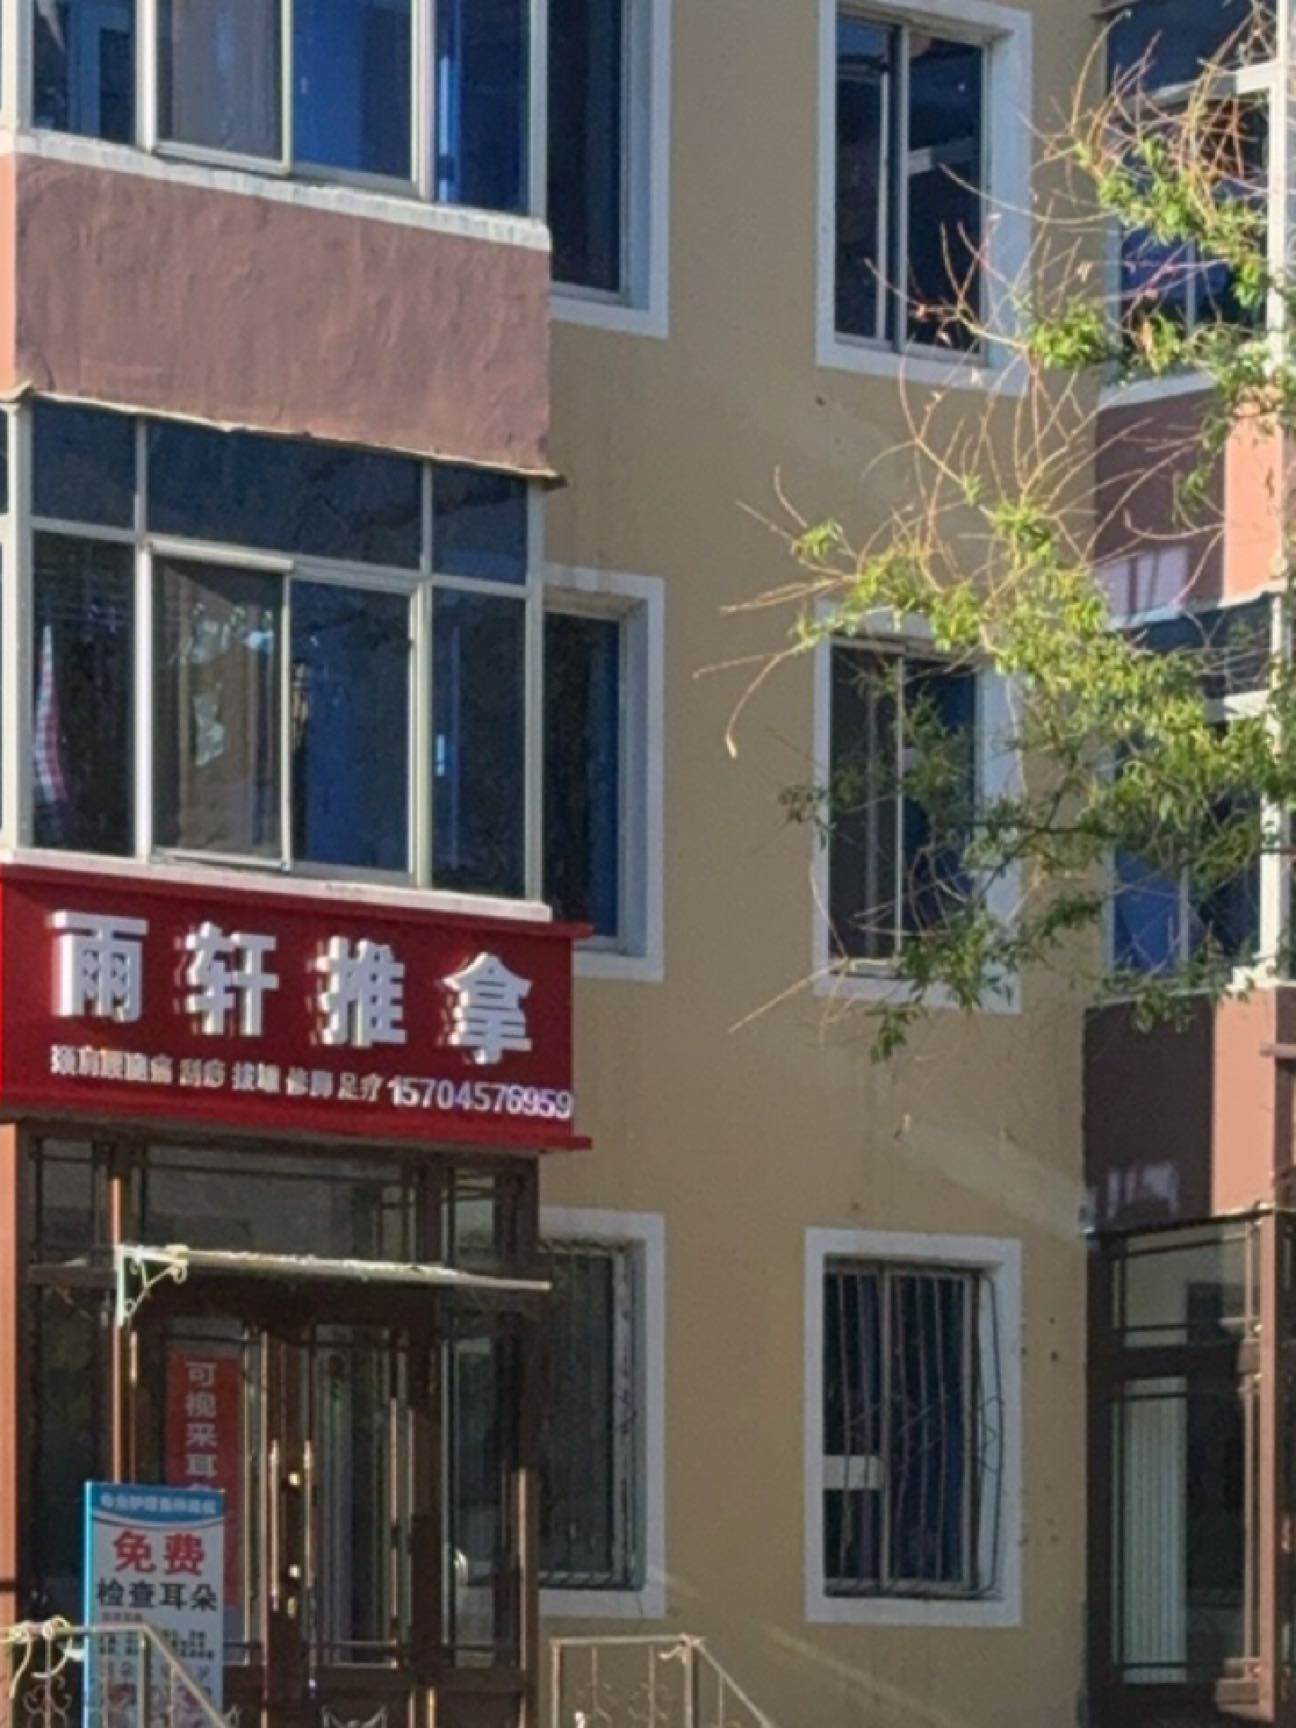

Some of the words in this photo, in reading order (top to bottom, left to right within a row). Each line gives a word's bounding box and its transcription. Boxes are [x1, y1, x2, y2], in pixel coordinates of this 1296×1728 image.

[48, 909, 534, 1066] 雨轩推拿
[337, 1071, 384, 1103] 足疗
[387, 1074, 572, 1120] 15704576959
[185, 1361, 218, 1491] 可视采耳
[113, 1529, 206, 1577] 免费
[96, 1576, 218, 1613] 检查耳朵
